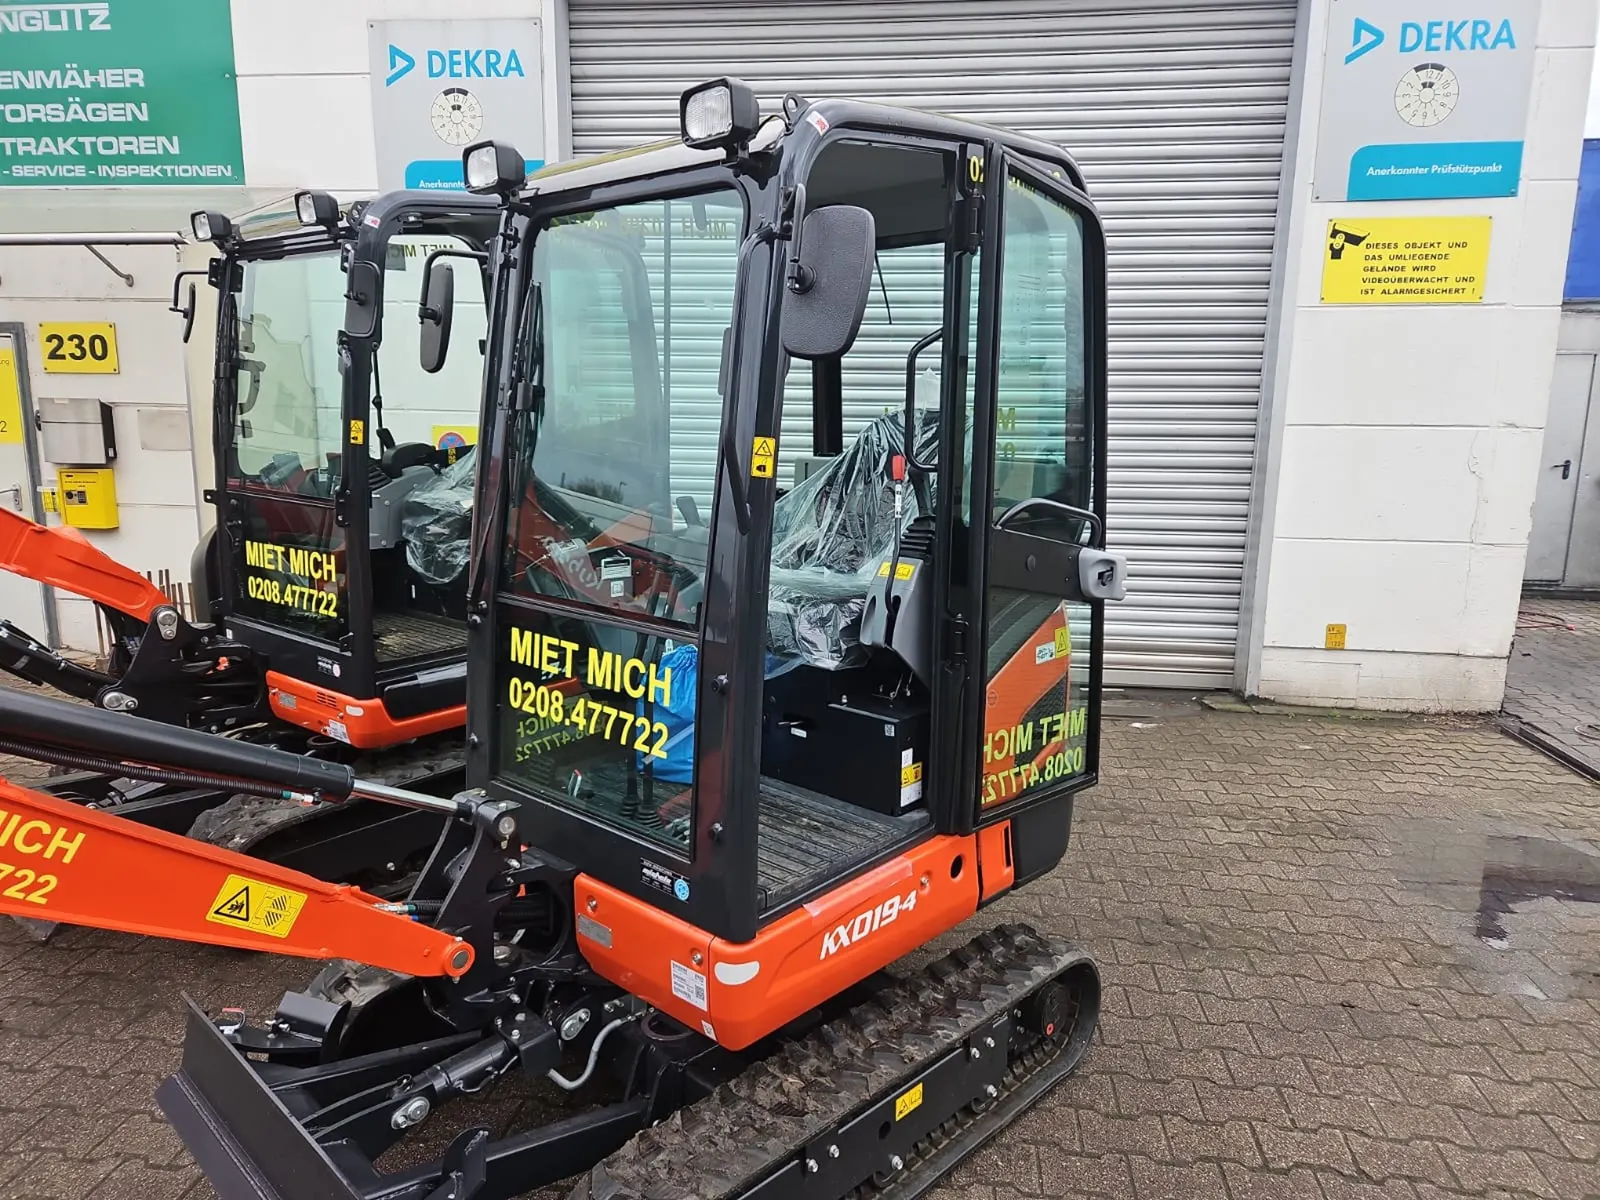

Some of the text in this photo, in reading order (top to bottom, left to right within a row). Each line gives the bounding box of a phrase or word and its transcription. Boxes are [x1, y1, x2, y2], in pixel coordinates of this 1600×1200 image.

[1399, 19, 1516, 53] DEKRA
[0, 64, 145, 89] ENMÄHER
[427, 49, 525, 78] DEKRA
[0, 136, 180, 155] TRAKTOREN
[12, 165, 86, 177] SERVICE
[97, 165, 232, 178] INSPEKTIONEN
[1366, 162, 1503, 176] Anerkannter Prüfstützpunkt
[1365, 241, 1468, 250] DIESES OBJEKT UND
[1388, 253, 1450, 261] UMLIEGENDE
[1380, 287, 1466, 295] ALARMGESICHERT
[45, 333, 108, 361] 230
[245, 540, 336, 582] MIET MICH
[248, 576, 338, 618] 0208.477722
[510, 627, 672, 707] MIET MICH
[509, 677, 669, 759] 0208.477722
[820, 889, 917, 960] KX019-4
